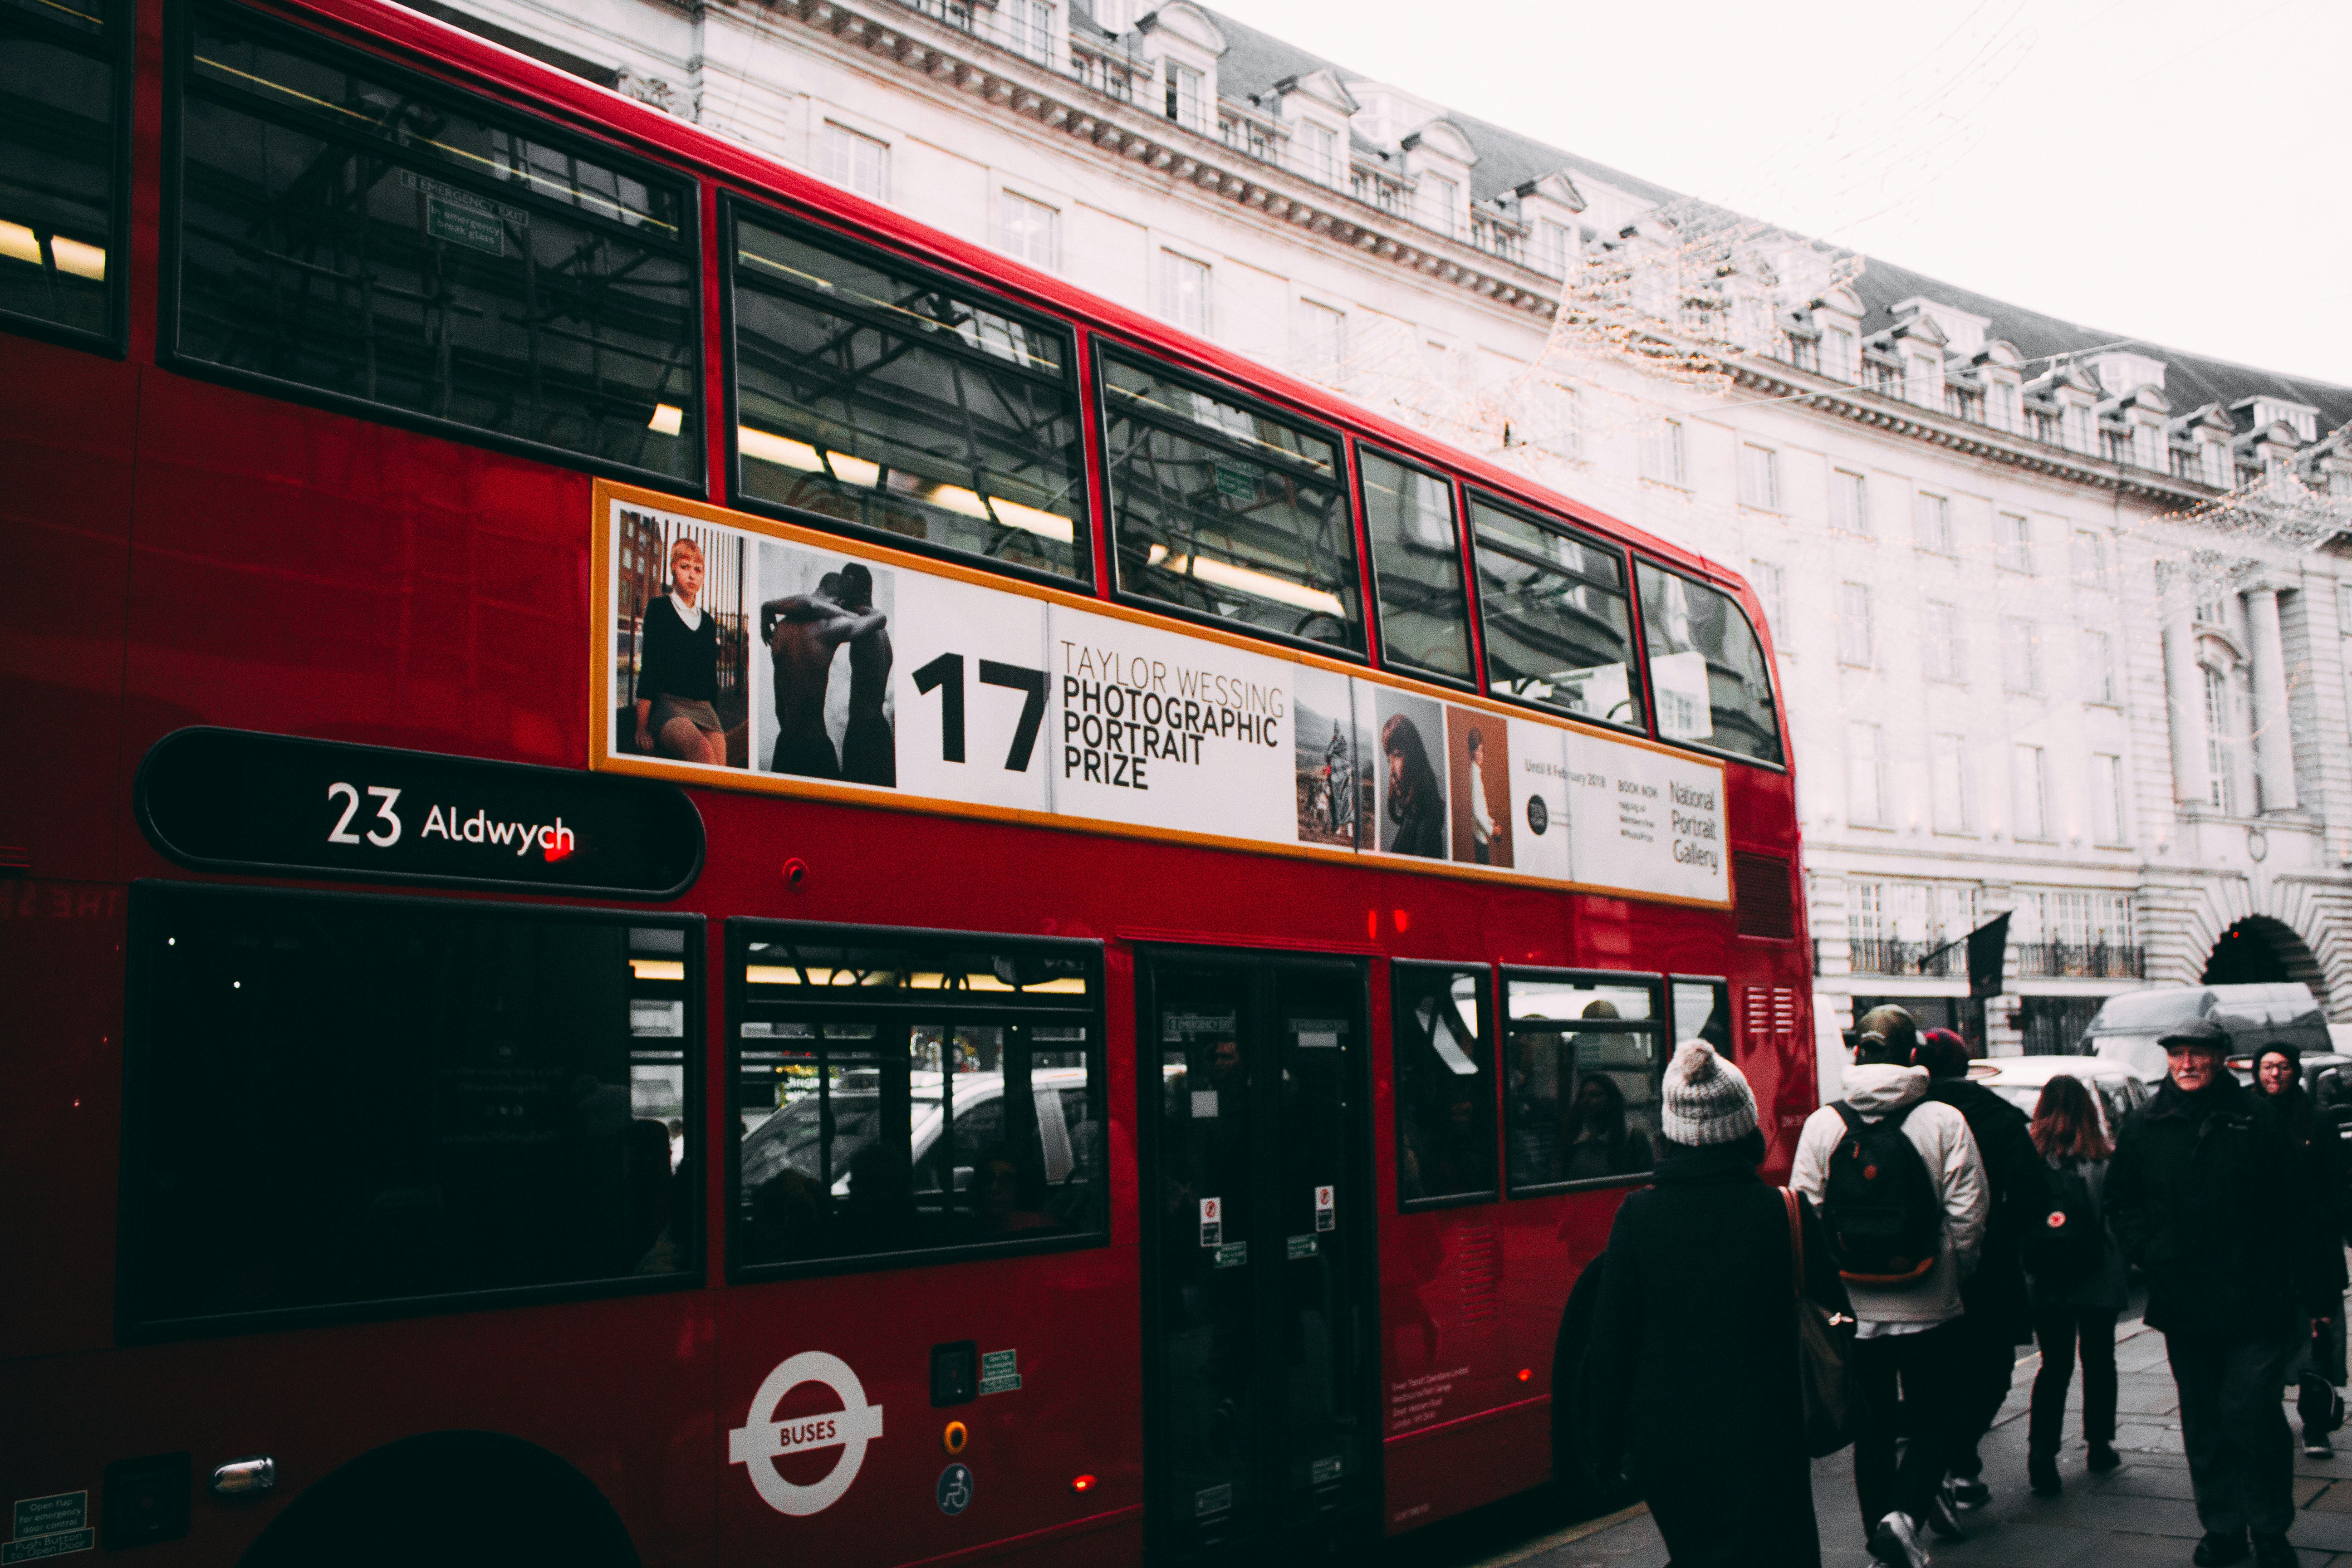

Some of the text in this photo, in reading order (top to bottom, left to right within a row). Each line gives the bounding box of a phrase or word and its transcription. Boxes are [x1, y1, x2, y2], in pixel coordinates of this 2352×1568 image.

[420, 178, 524, 222] EMERGENCY EXIT
[444, 211, 500, 237] emergency
[1061, 640, 1284, 718] TAYLOR WESSING
[911, 652, 1051, 772] 17
[1063, 675, 1278, 748] PHOTOGRAPHIC
[1063, 710, 1205, 765] PORTRAIT
[1065, 745, 1149, 790] PRIZE
[1669, 778, 1715, 812] National
[327, 781, 575, 856] 23 Aldwych
[1671, 808, 1716, 841] Portrait
[1672, 838, 1719, 876] Gallery
[781, 1420, 836, 1446] BUSES
[19, 1507, 82, 1524] for emergency
[29, 1499, 73, 1512] Open flap
[15, 1533, 83, 1551] Push Button
[23, 1518, 78, 1534] door control
[10, 1540, 85, 1560] to Open Door
